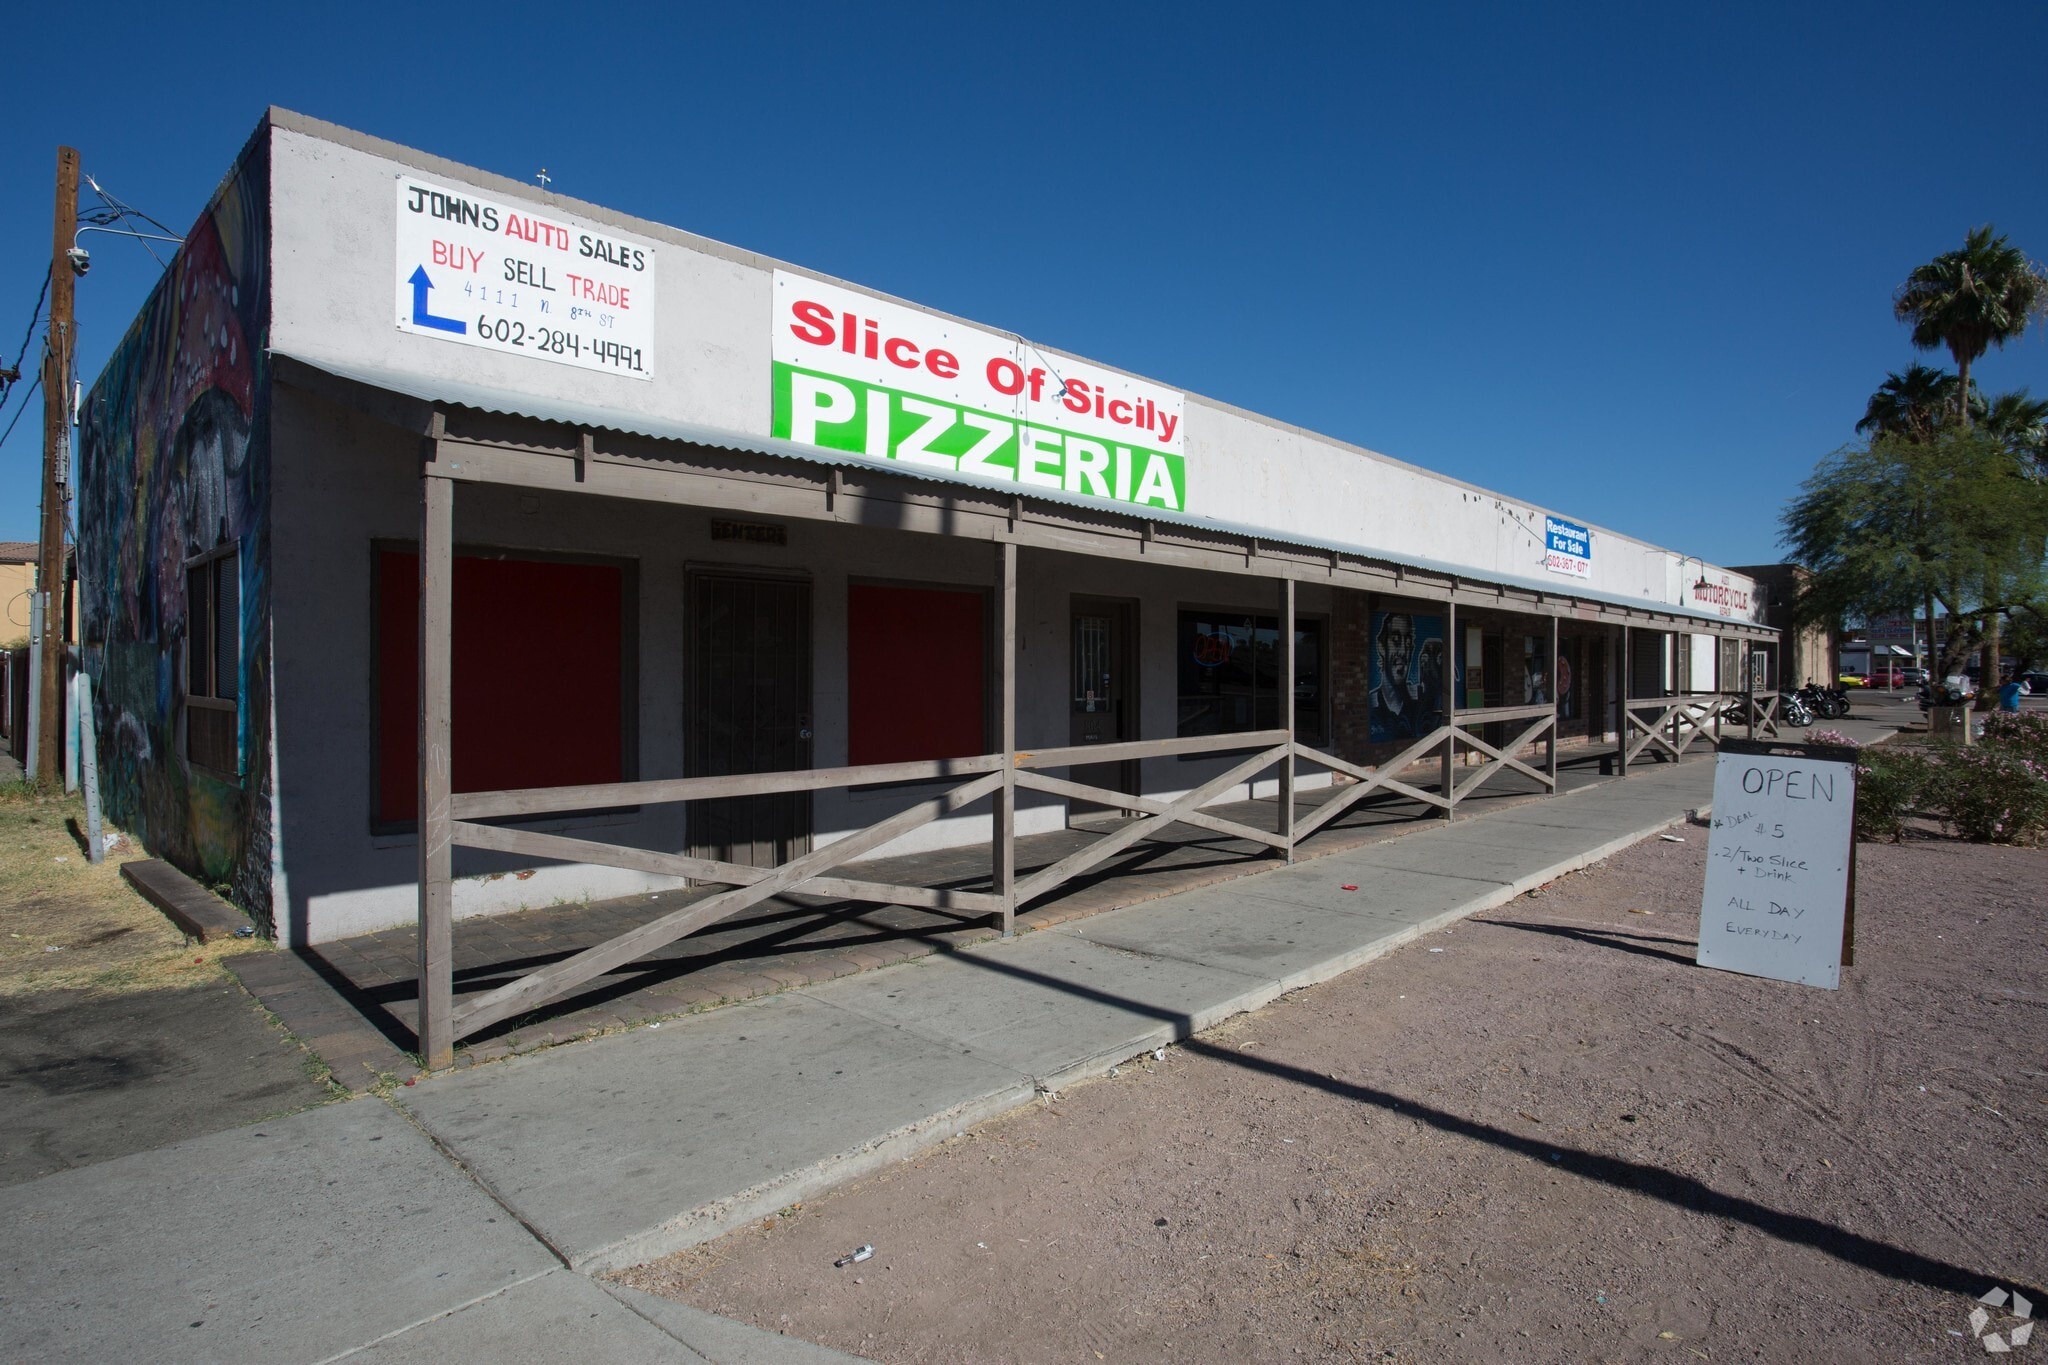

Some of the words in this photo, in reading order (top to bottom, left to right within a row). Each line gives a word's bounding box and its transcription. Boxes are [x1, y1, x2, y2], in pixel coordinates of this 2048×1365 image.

[408, 185, 499, 232] JOHNS
[505, 213, 569, 251] AUTO
[579, 234, 645, 272] SALES
[432, 239, 485, 273] BUY
[503, 257, 556, 292] SELL
[566, 273, 630, 310] TRADE
[599, 313, 615, 329] ST
[477, 314, 643, 372] 602-284-4991
[790, 299, 960, 380] Slice
[985, 356, 1046, 403] Of
[1062, 377, 1179, 444] Sicily
[790, 370, 1179, 510] PIZZERIA
[1546, 518, 1588, 544] Restaurant
[1553, 536, 1567, 551] For
[1567, 539, 1584, 555] Sale
[1694, 579, 1748, 610] MOTORCYCLE
[1194, 633, 1232, 663] OPEN
[1742, 767, 1834, 802] OPEN
[1754, 866, 1797, 884] Drink
[1769, 854, 1809, 871] Slice
[1727, 896, 1756, 911] ALL
[1767, 901, 1805, 919] DAY
[1726, 921, 1802, 944] EVERYDAY
